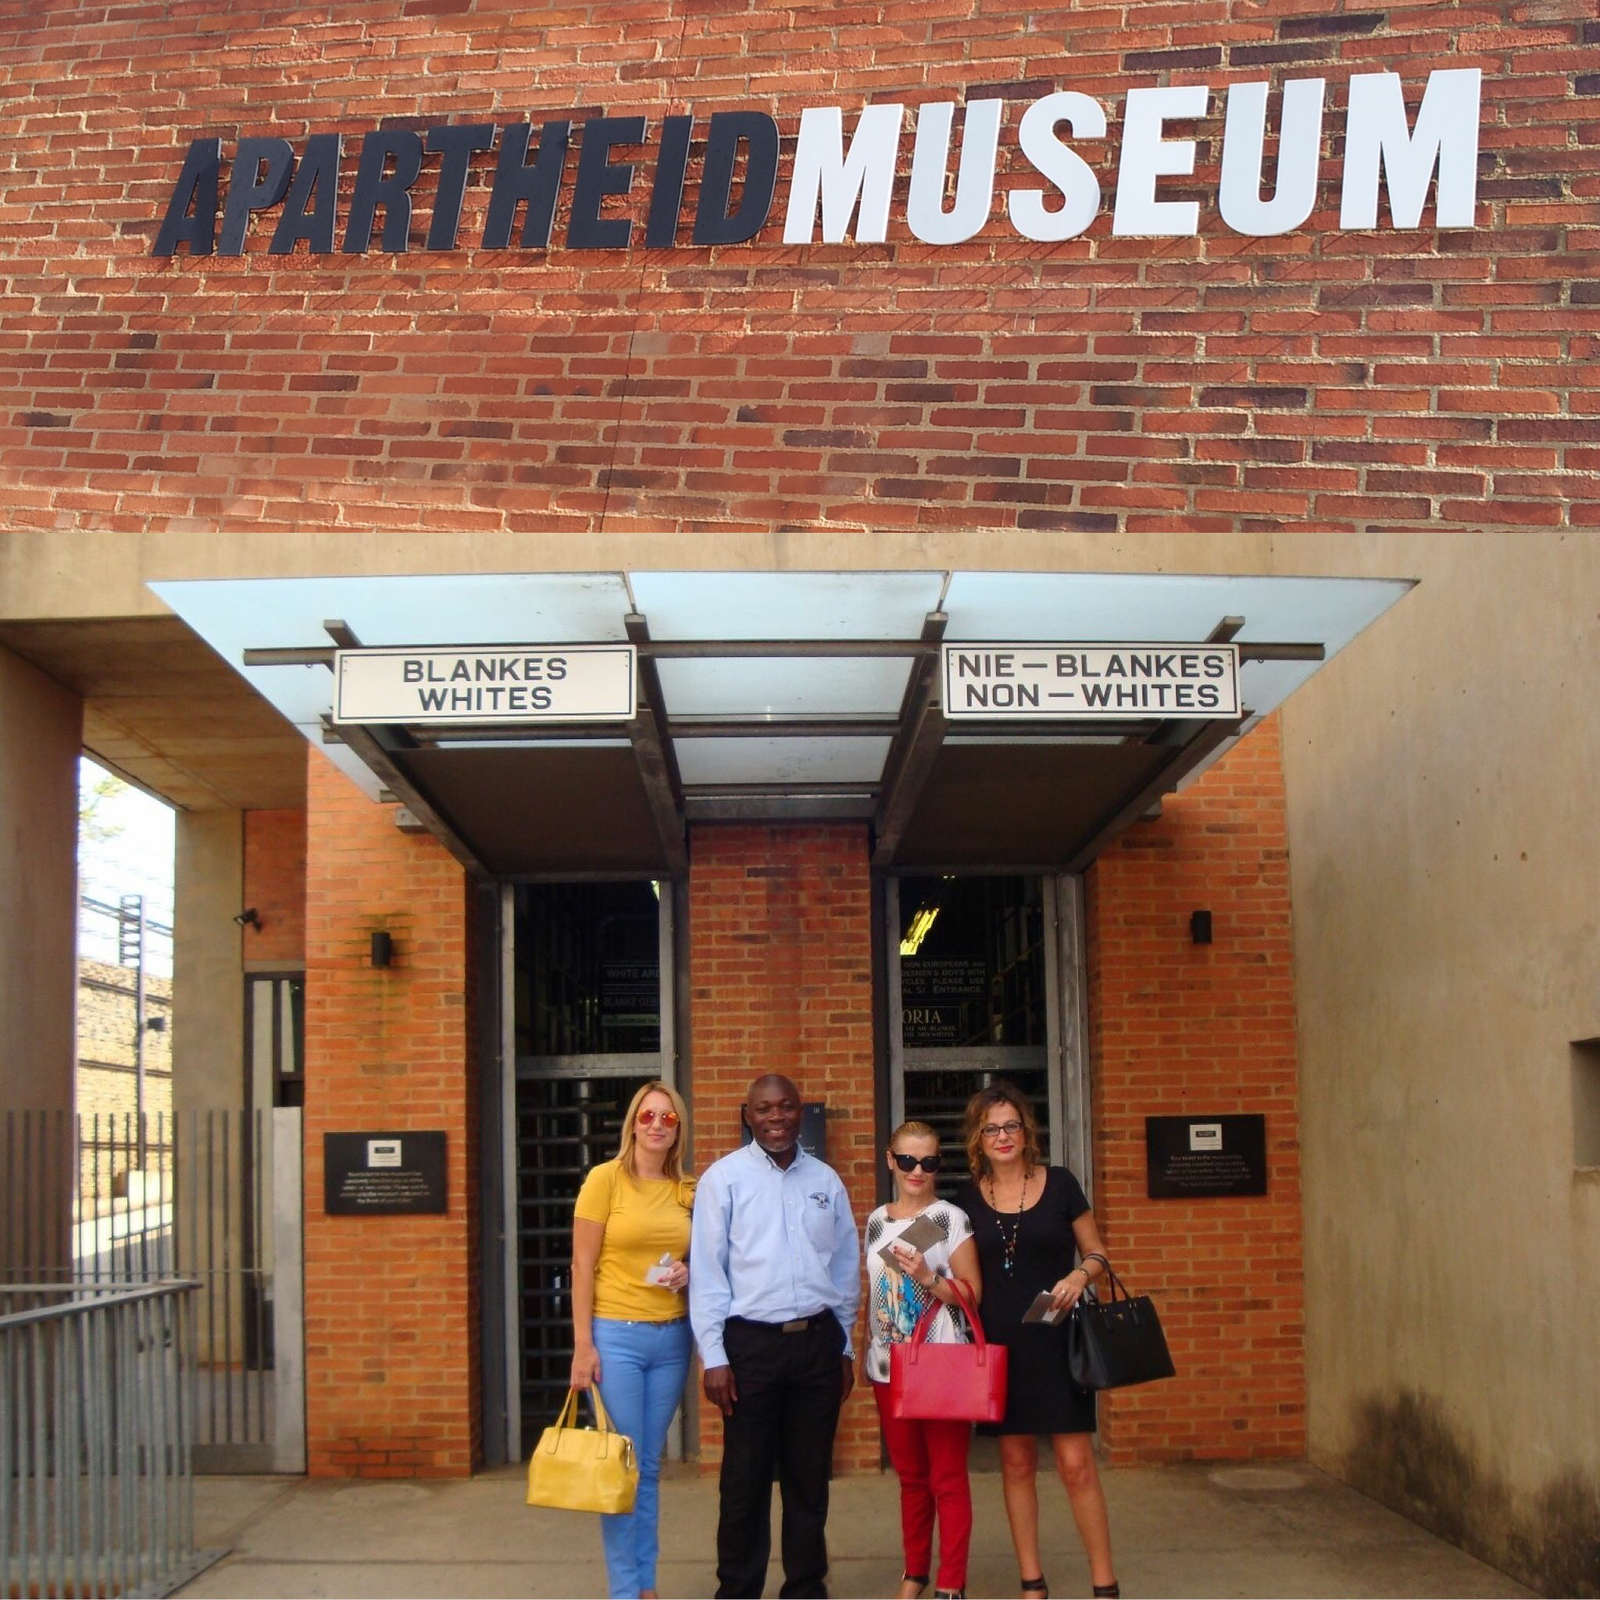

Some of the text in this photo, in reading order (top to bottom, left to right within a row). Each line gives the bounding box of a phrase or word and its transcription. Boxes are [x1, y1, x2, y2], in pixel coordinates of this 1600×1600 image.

[151, 67, 1482, 257] APARTHEID MUSEUM
[403, 657, 568, 683] BLANKES
[418, 685, 553, 711] WHITES
